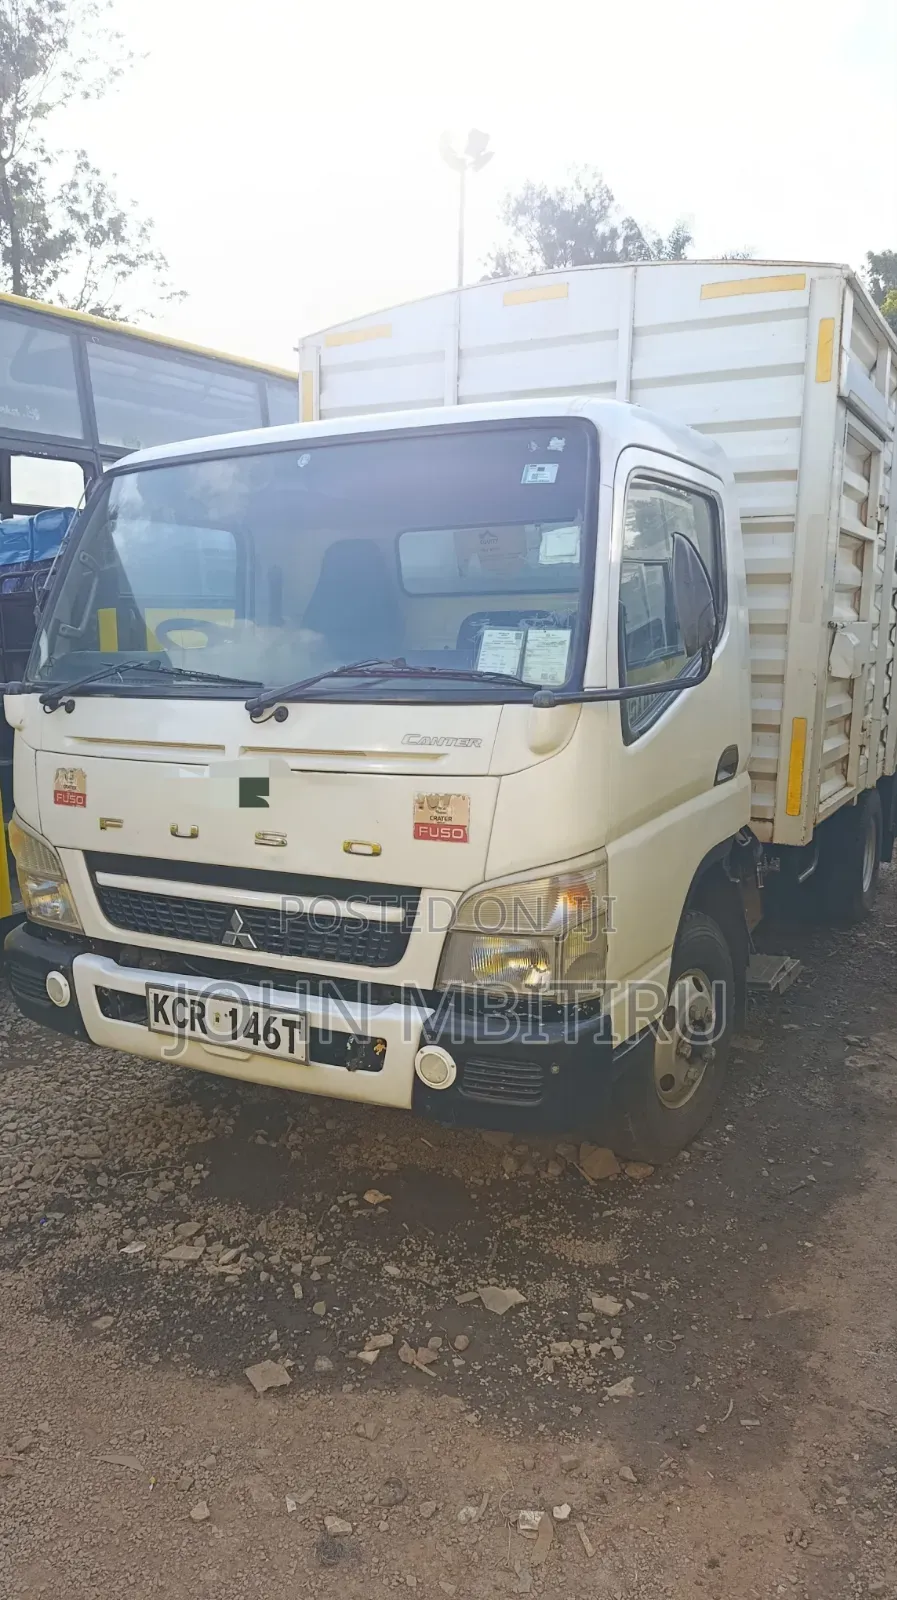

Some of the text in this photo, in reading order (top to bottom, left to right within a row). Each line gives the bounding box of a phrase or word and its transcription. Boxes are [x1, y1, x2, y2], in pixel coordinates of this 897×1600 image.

[400, 733, 483, 748] CANTER
[56, 793, 84, 805] FUSO
[419, 826, 464, 839] FUSO
[153, 993, 301, 1054] KCR 146T
